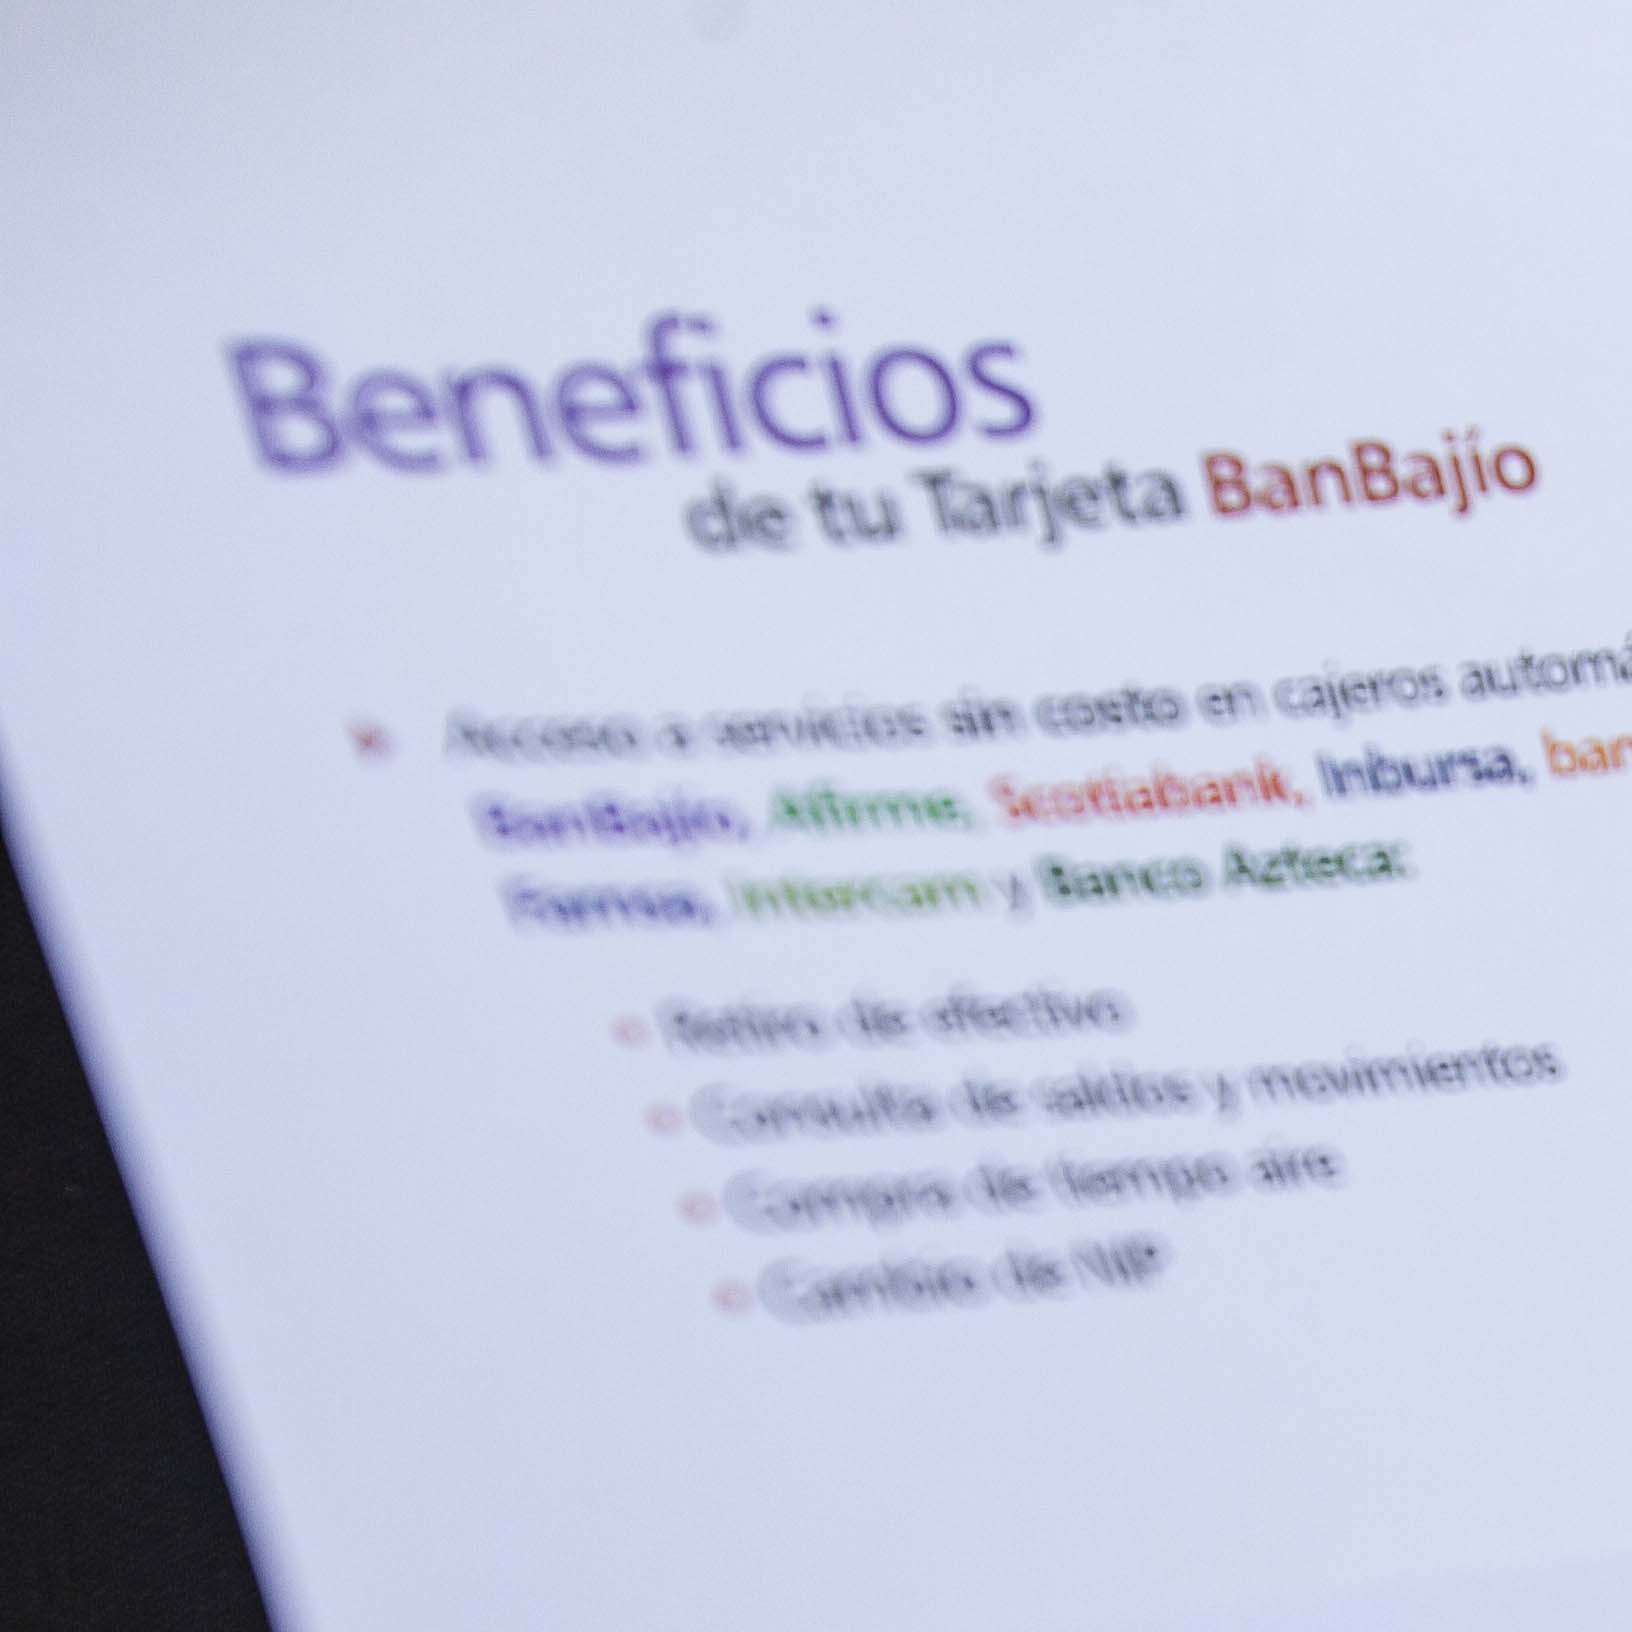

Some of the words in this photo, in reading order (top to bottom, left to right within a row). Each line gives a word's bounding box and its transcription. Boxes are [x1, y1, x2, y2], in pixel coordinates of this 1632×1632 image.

[225, 306, 1038, 474] Beneficios
[673, 481, 810, 552] de
[799, 473, 907, 544] tu
[913, 452, 1194, 545] Tarjeta
[1194, 429, 1547, 519] BanBajío
[938, 685, 1024, 742] sin
[1033, 674, 1192, 736] costo
[1195, 680, 1264, 725] en
[1264, 658, 1453, 727] cajeros
[987, 752, 1312, 825] Scotiabank,
[1309, 741, 1541, 802] Inbursa,
